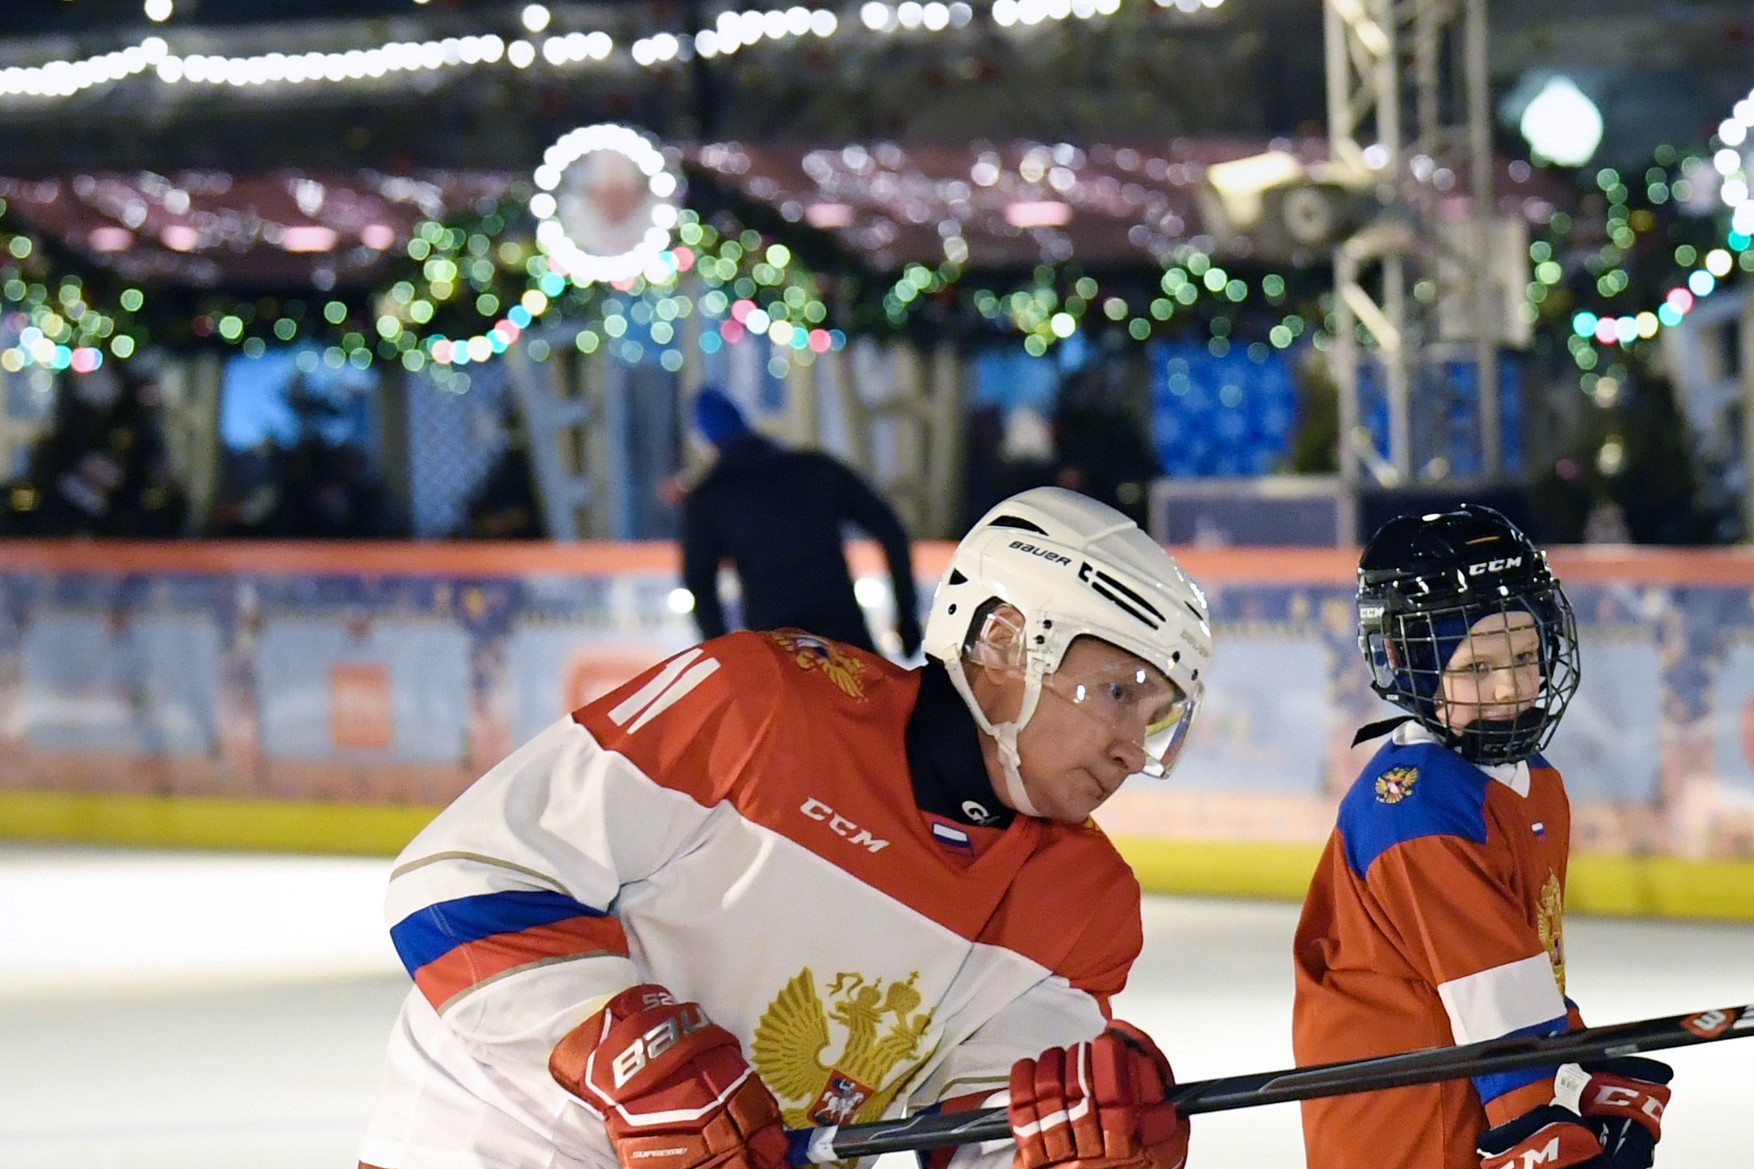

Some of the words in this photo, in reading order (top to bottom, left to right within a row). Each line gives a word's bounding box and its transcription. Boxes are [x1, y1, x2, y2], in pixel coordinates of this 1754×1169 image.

[1468, 556, 1523, 577] CCM
[1360, 606, 1385, 619] CCM
[800, 797, 890, 853] CCM
